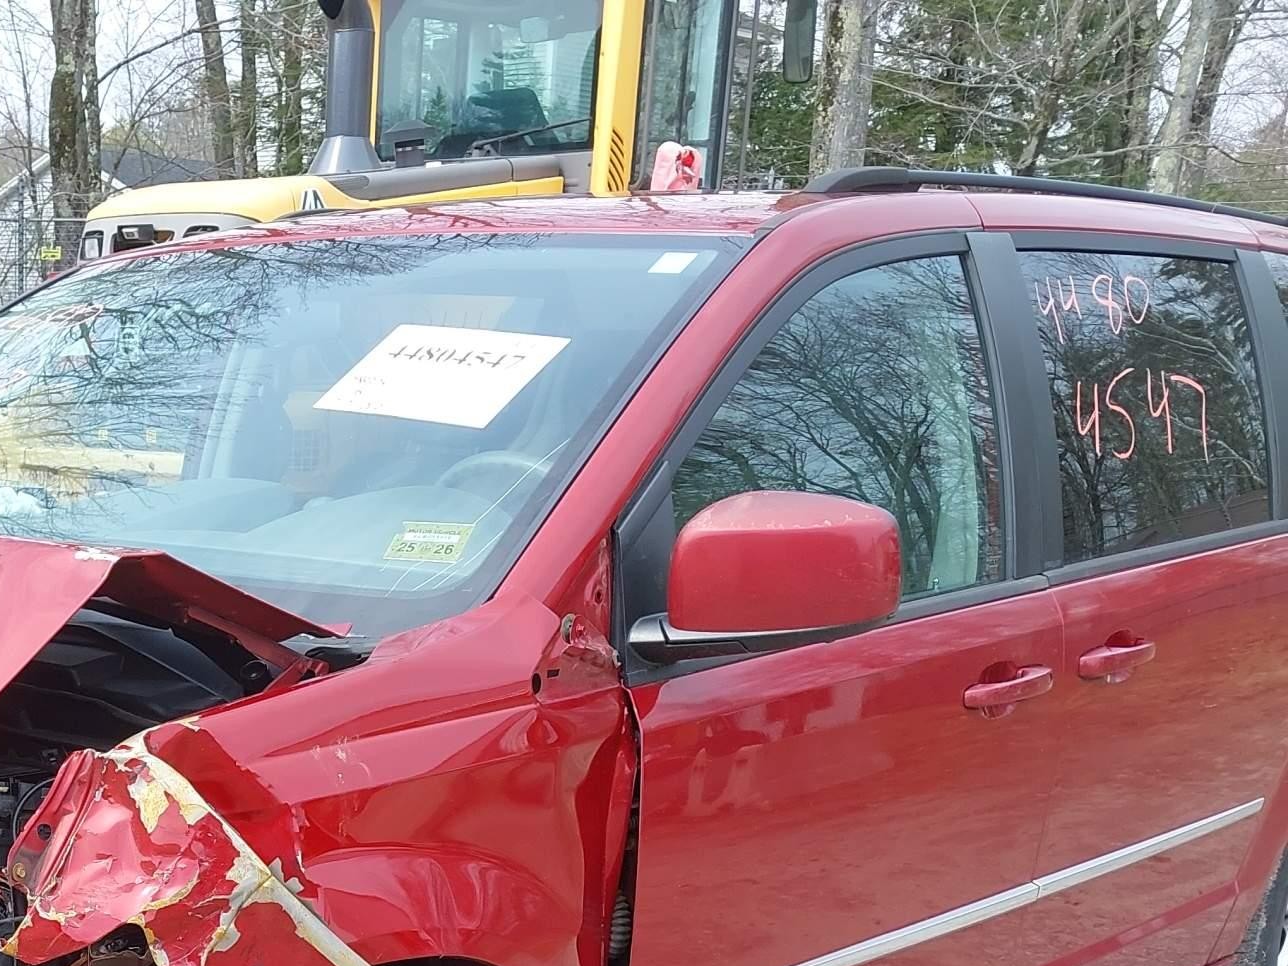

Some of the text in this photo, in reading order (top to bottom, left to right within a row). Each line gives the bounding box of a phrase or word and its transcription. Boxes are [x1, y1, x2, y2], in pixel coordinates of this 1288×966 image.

[1034, 273, 1150, 345] 4480
[1075, 367, 1209, 464] 4547
[397, 542, 417, 553] 25
[433, 544, 455, 555] 26
